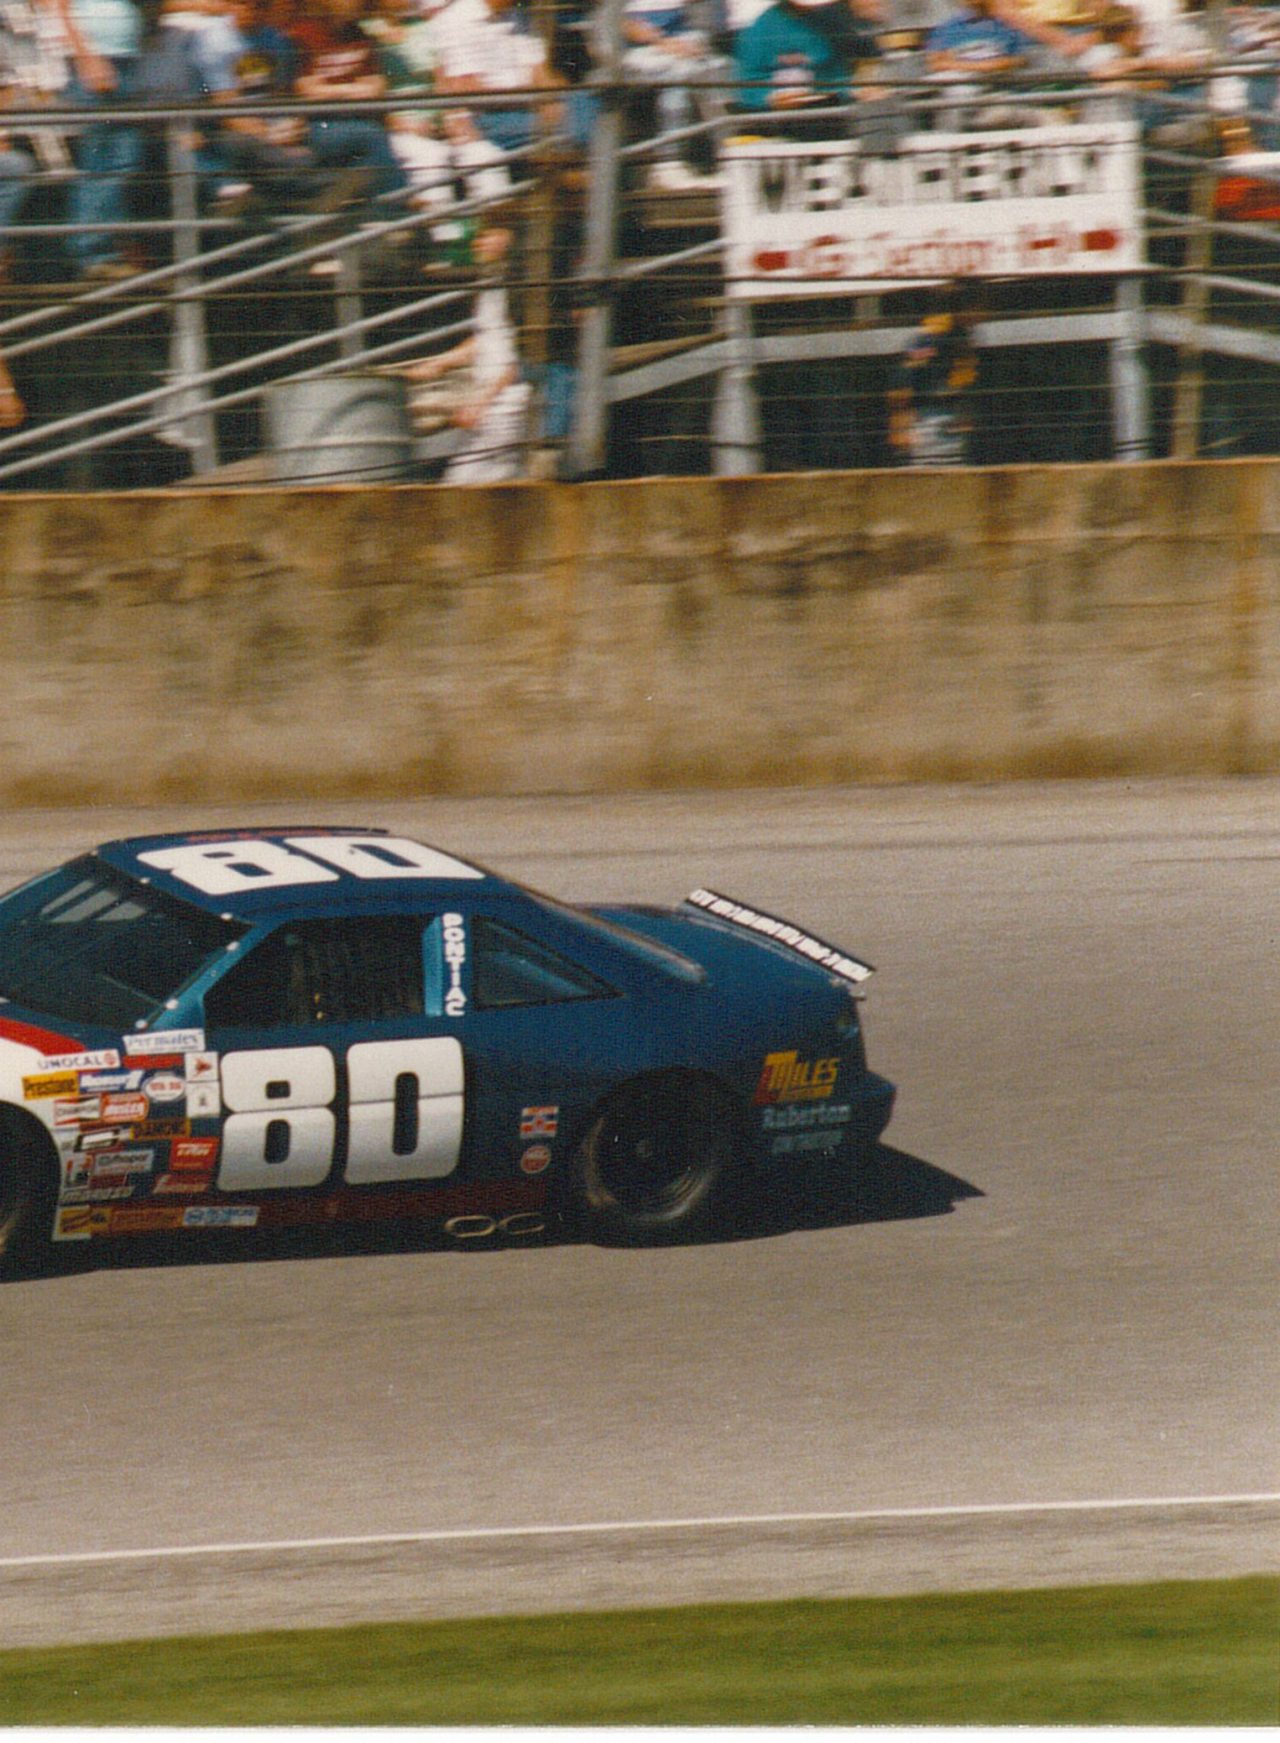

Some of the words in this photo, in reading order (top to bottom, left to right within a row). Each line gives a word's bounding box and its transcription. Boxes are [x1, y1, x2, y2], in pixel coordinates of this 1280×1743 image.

[755, 143, 1108, 214] WEATHERLY
[136, 837, 486, 895] 80
[442, 912, 467, 1017] PONTIAC
[37, 1054, 103, 1070] UNOCAL
[217, 1036, 465, 1192] 80
